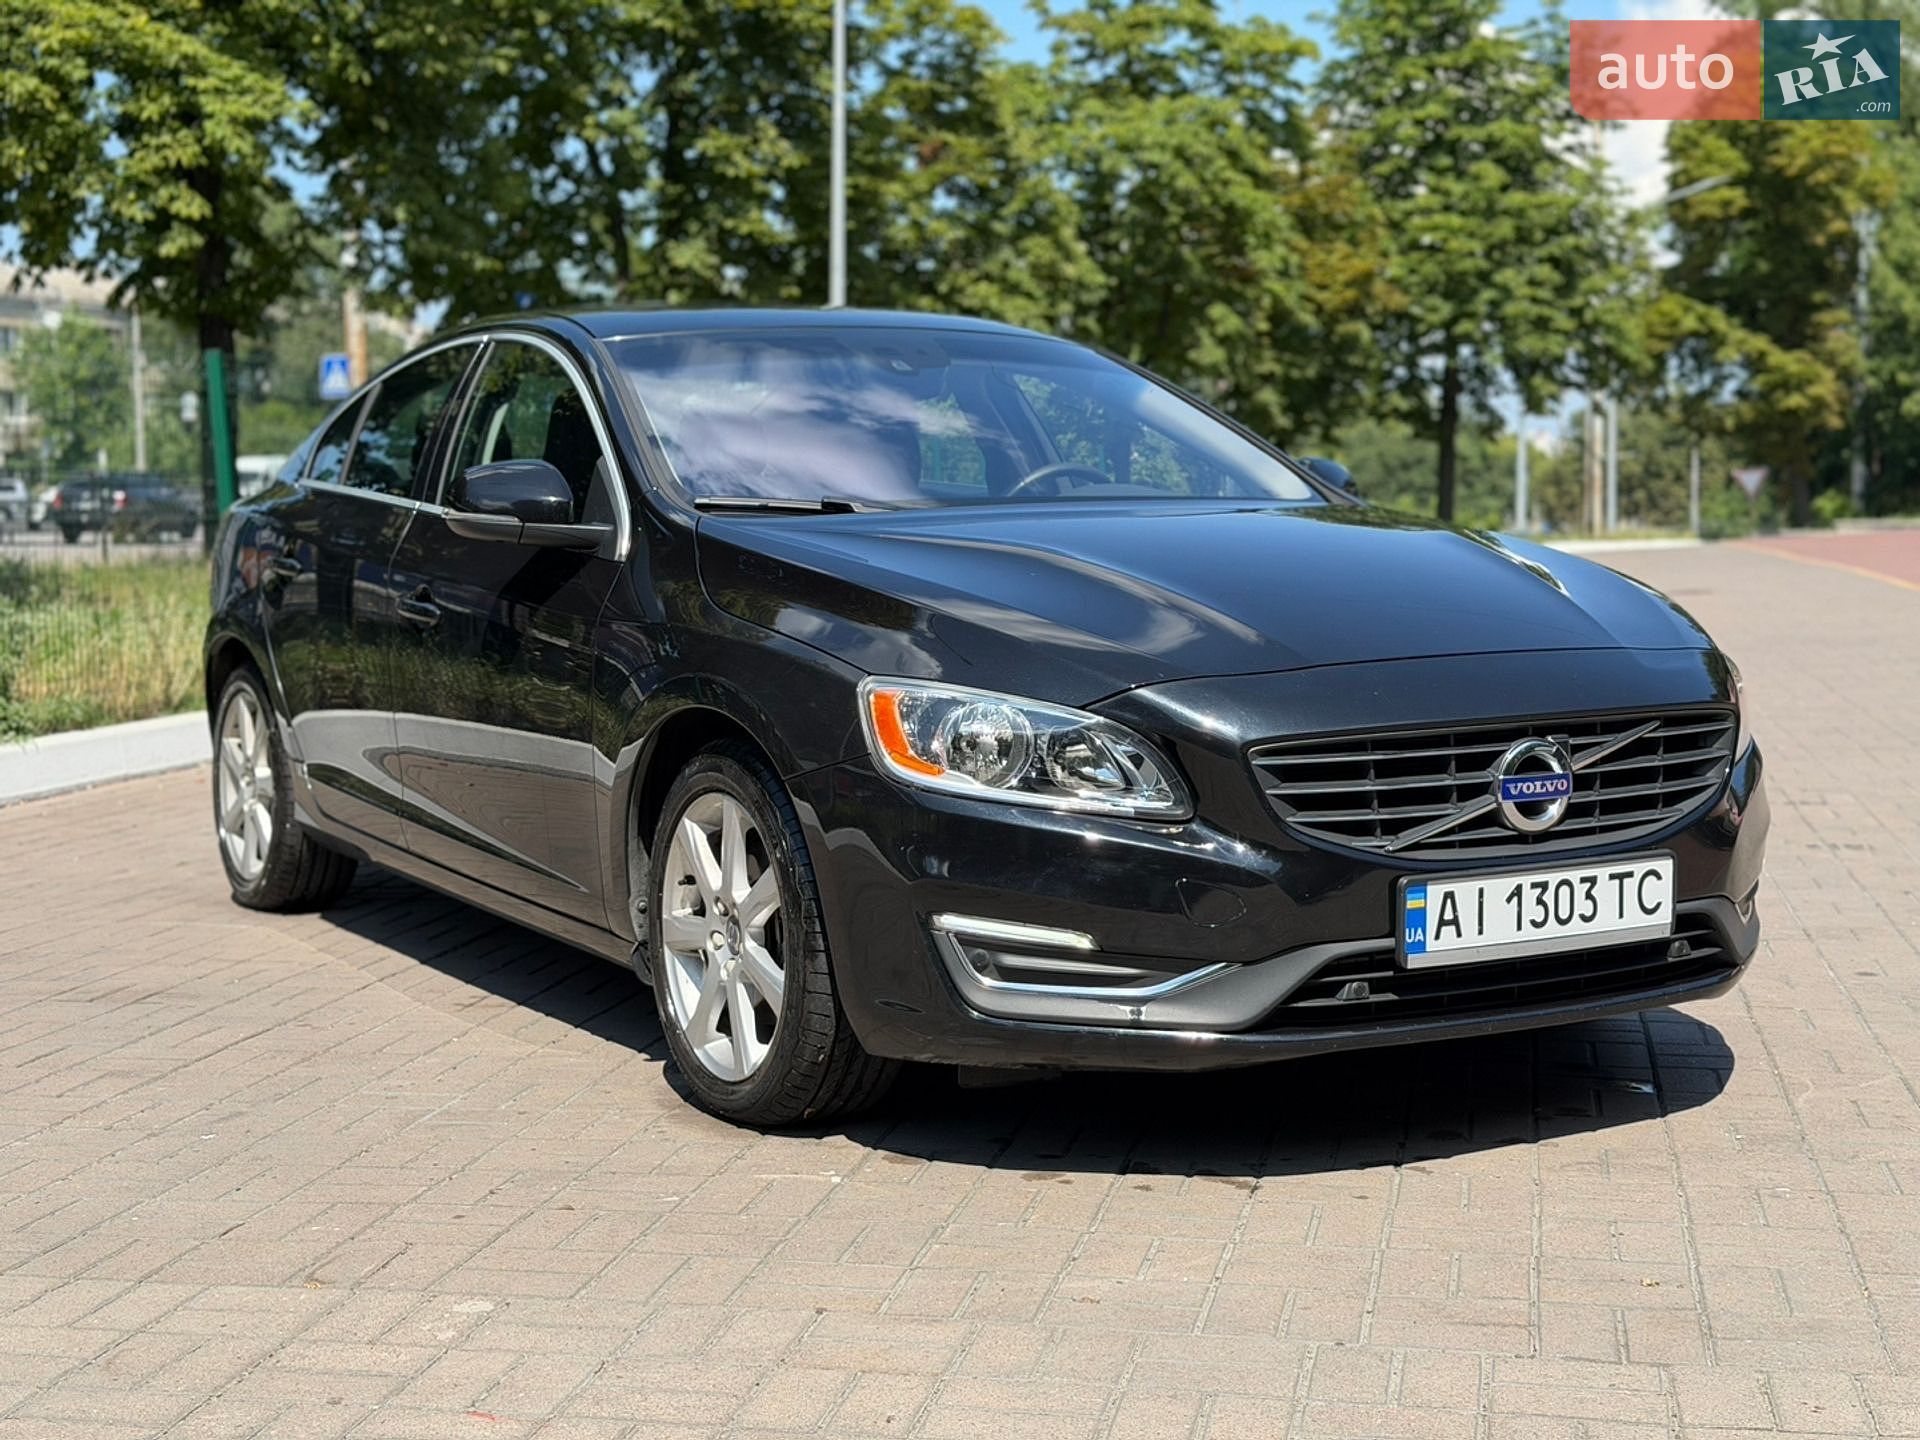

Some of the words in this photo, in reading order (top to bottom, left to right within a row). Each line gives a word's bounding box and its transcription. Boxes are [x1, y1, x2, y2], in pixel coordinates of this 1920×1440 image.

[1506, 778, 1568, 796] VOLVO
[1505, 875, 1599, 932] 1303
[1608, 868, 1663, 920] TC
[1405, 927, 1425, 943] UA
